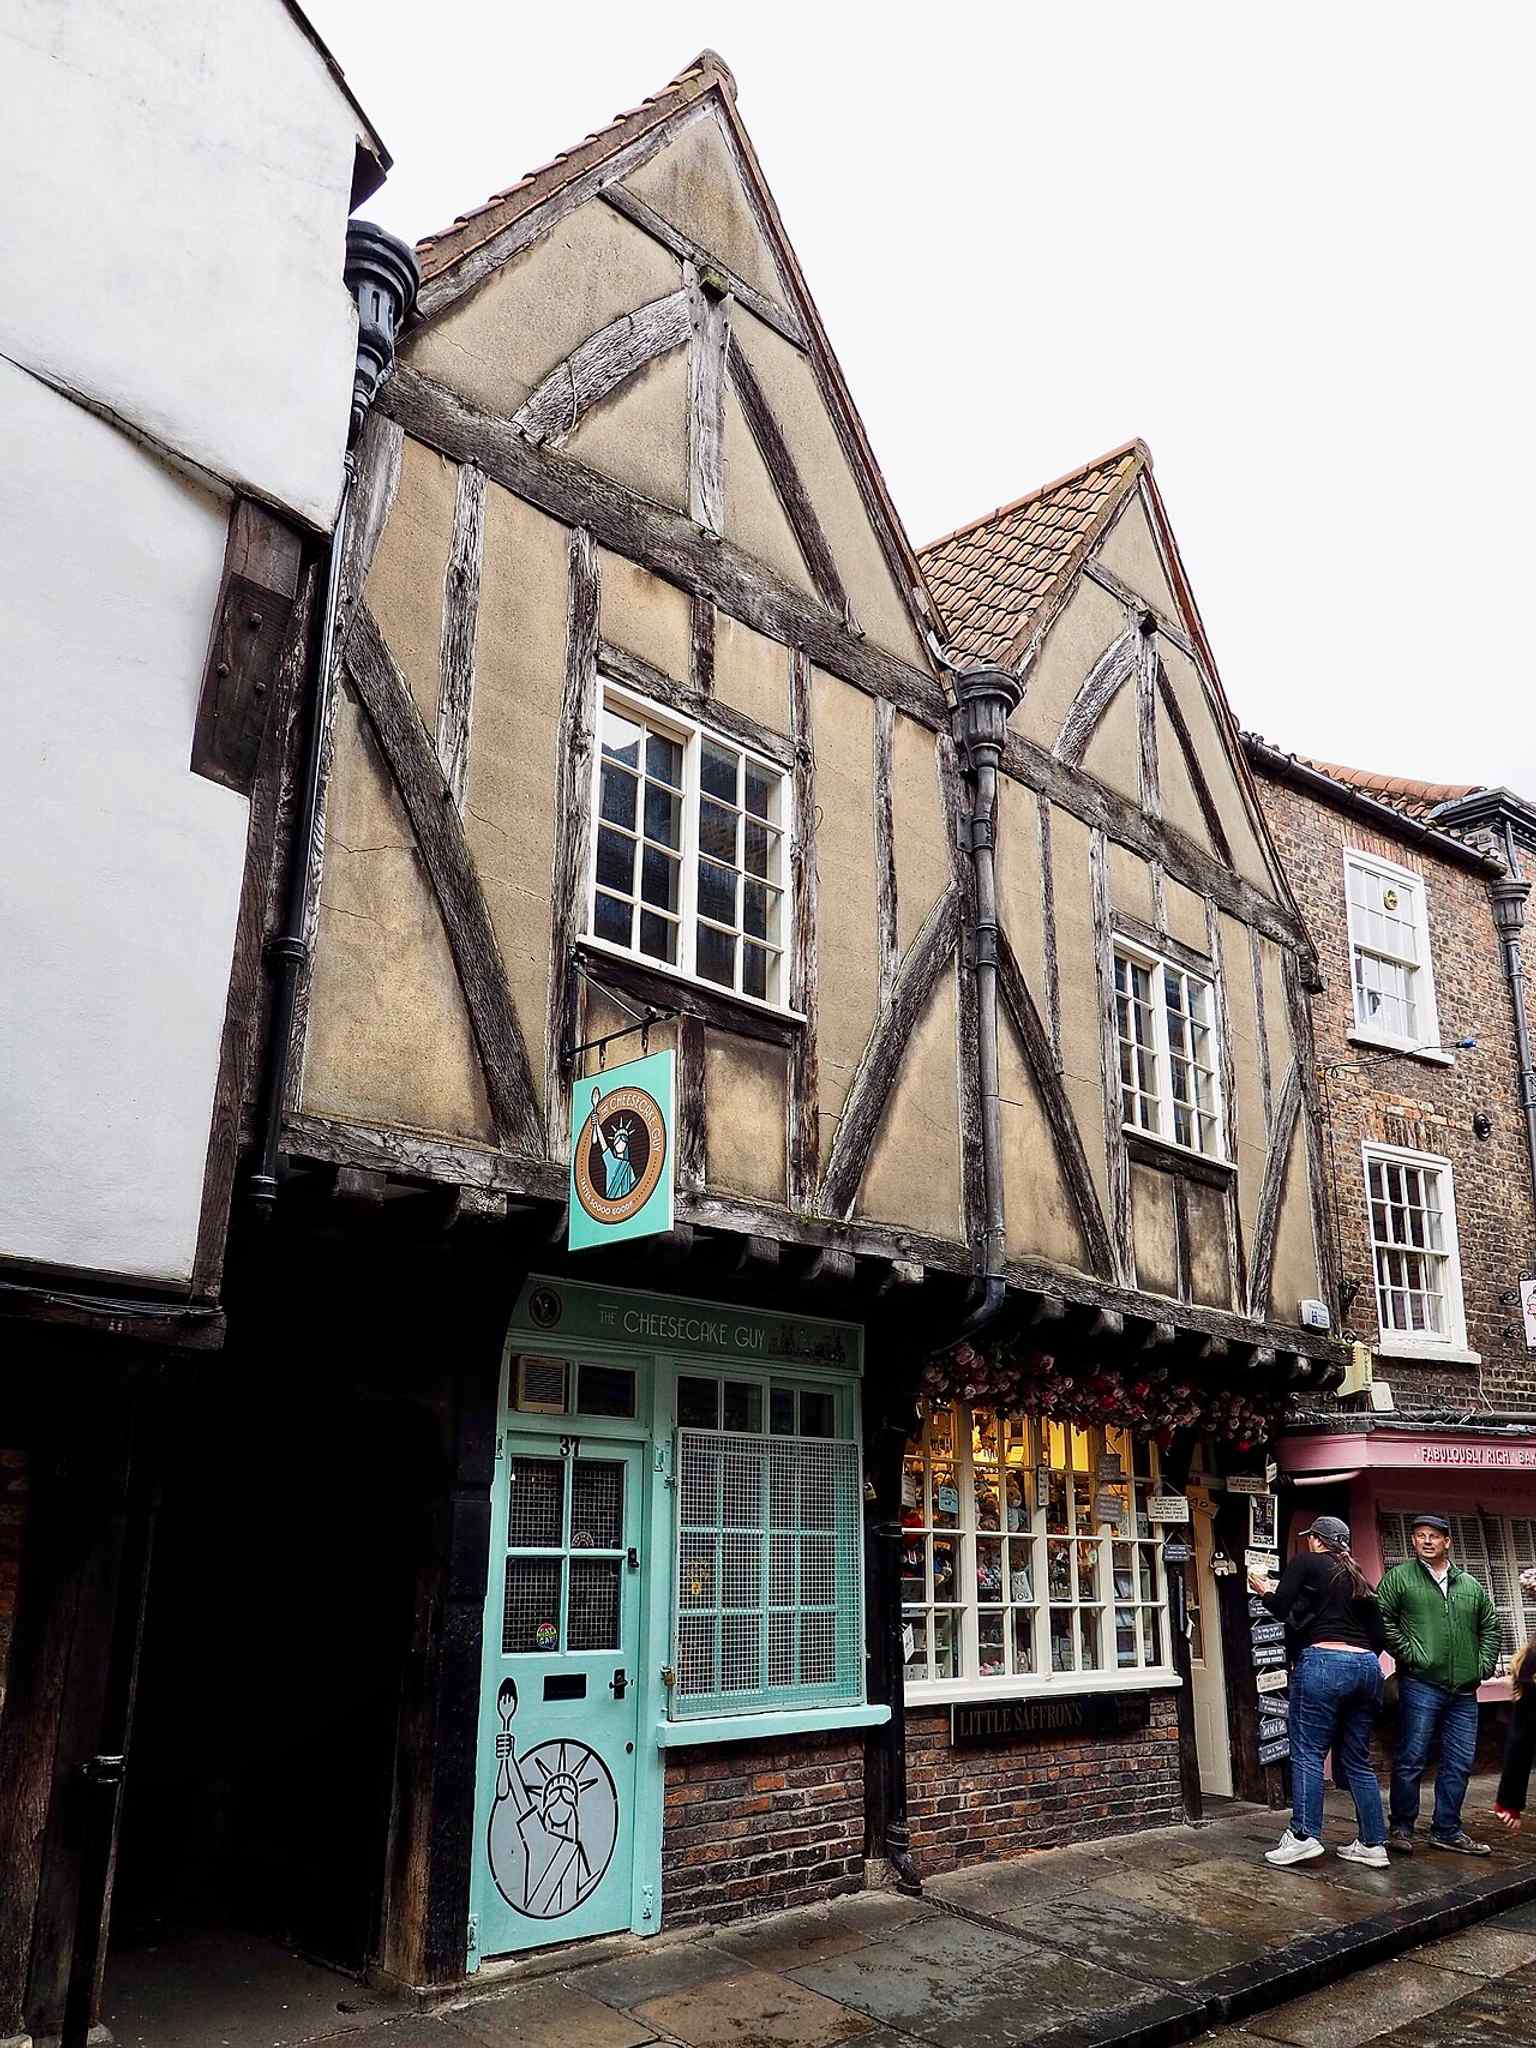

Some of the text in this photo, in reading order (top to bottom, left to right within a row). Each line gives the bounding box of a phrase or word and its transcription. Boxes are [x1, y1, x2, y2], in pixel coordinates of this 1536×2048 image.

[610, 1094, 658, 1127] CHEESECAKE
[651, 1128, 662, 1153] GUY
[600, 1310, 766, 1349] THE CHEESECAKE GUY
[560, 1436, 580, 1457] 37
[1421, 1446, 1484, 1464] FABULOUSLY
[1487, 1448, 1511, 1465] RICH
[960, 1709, 1010, 1737] LITTLE
